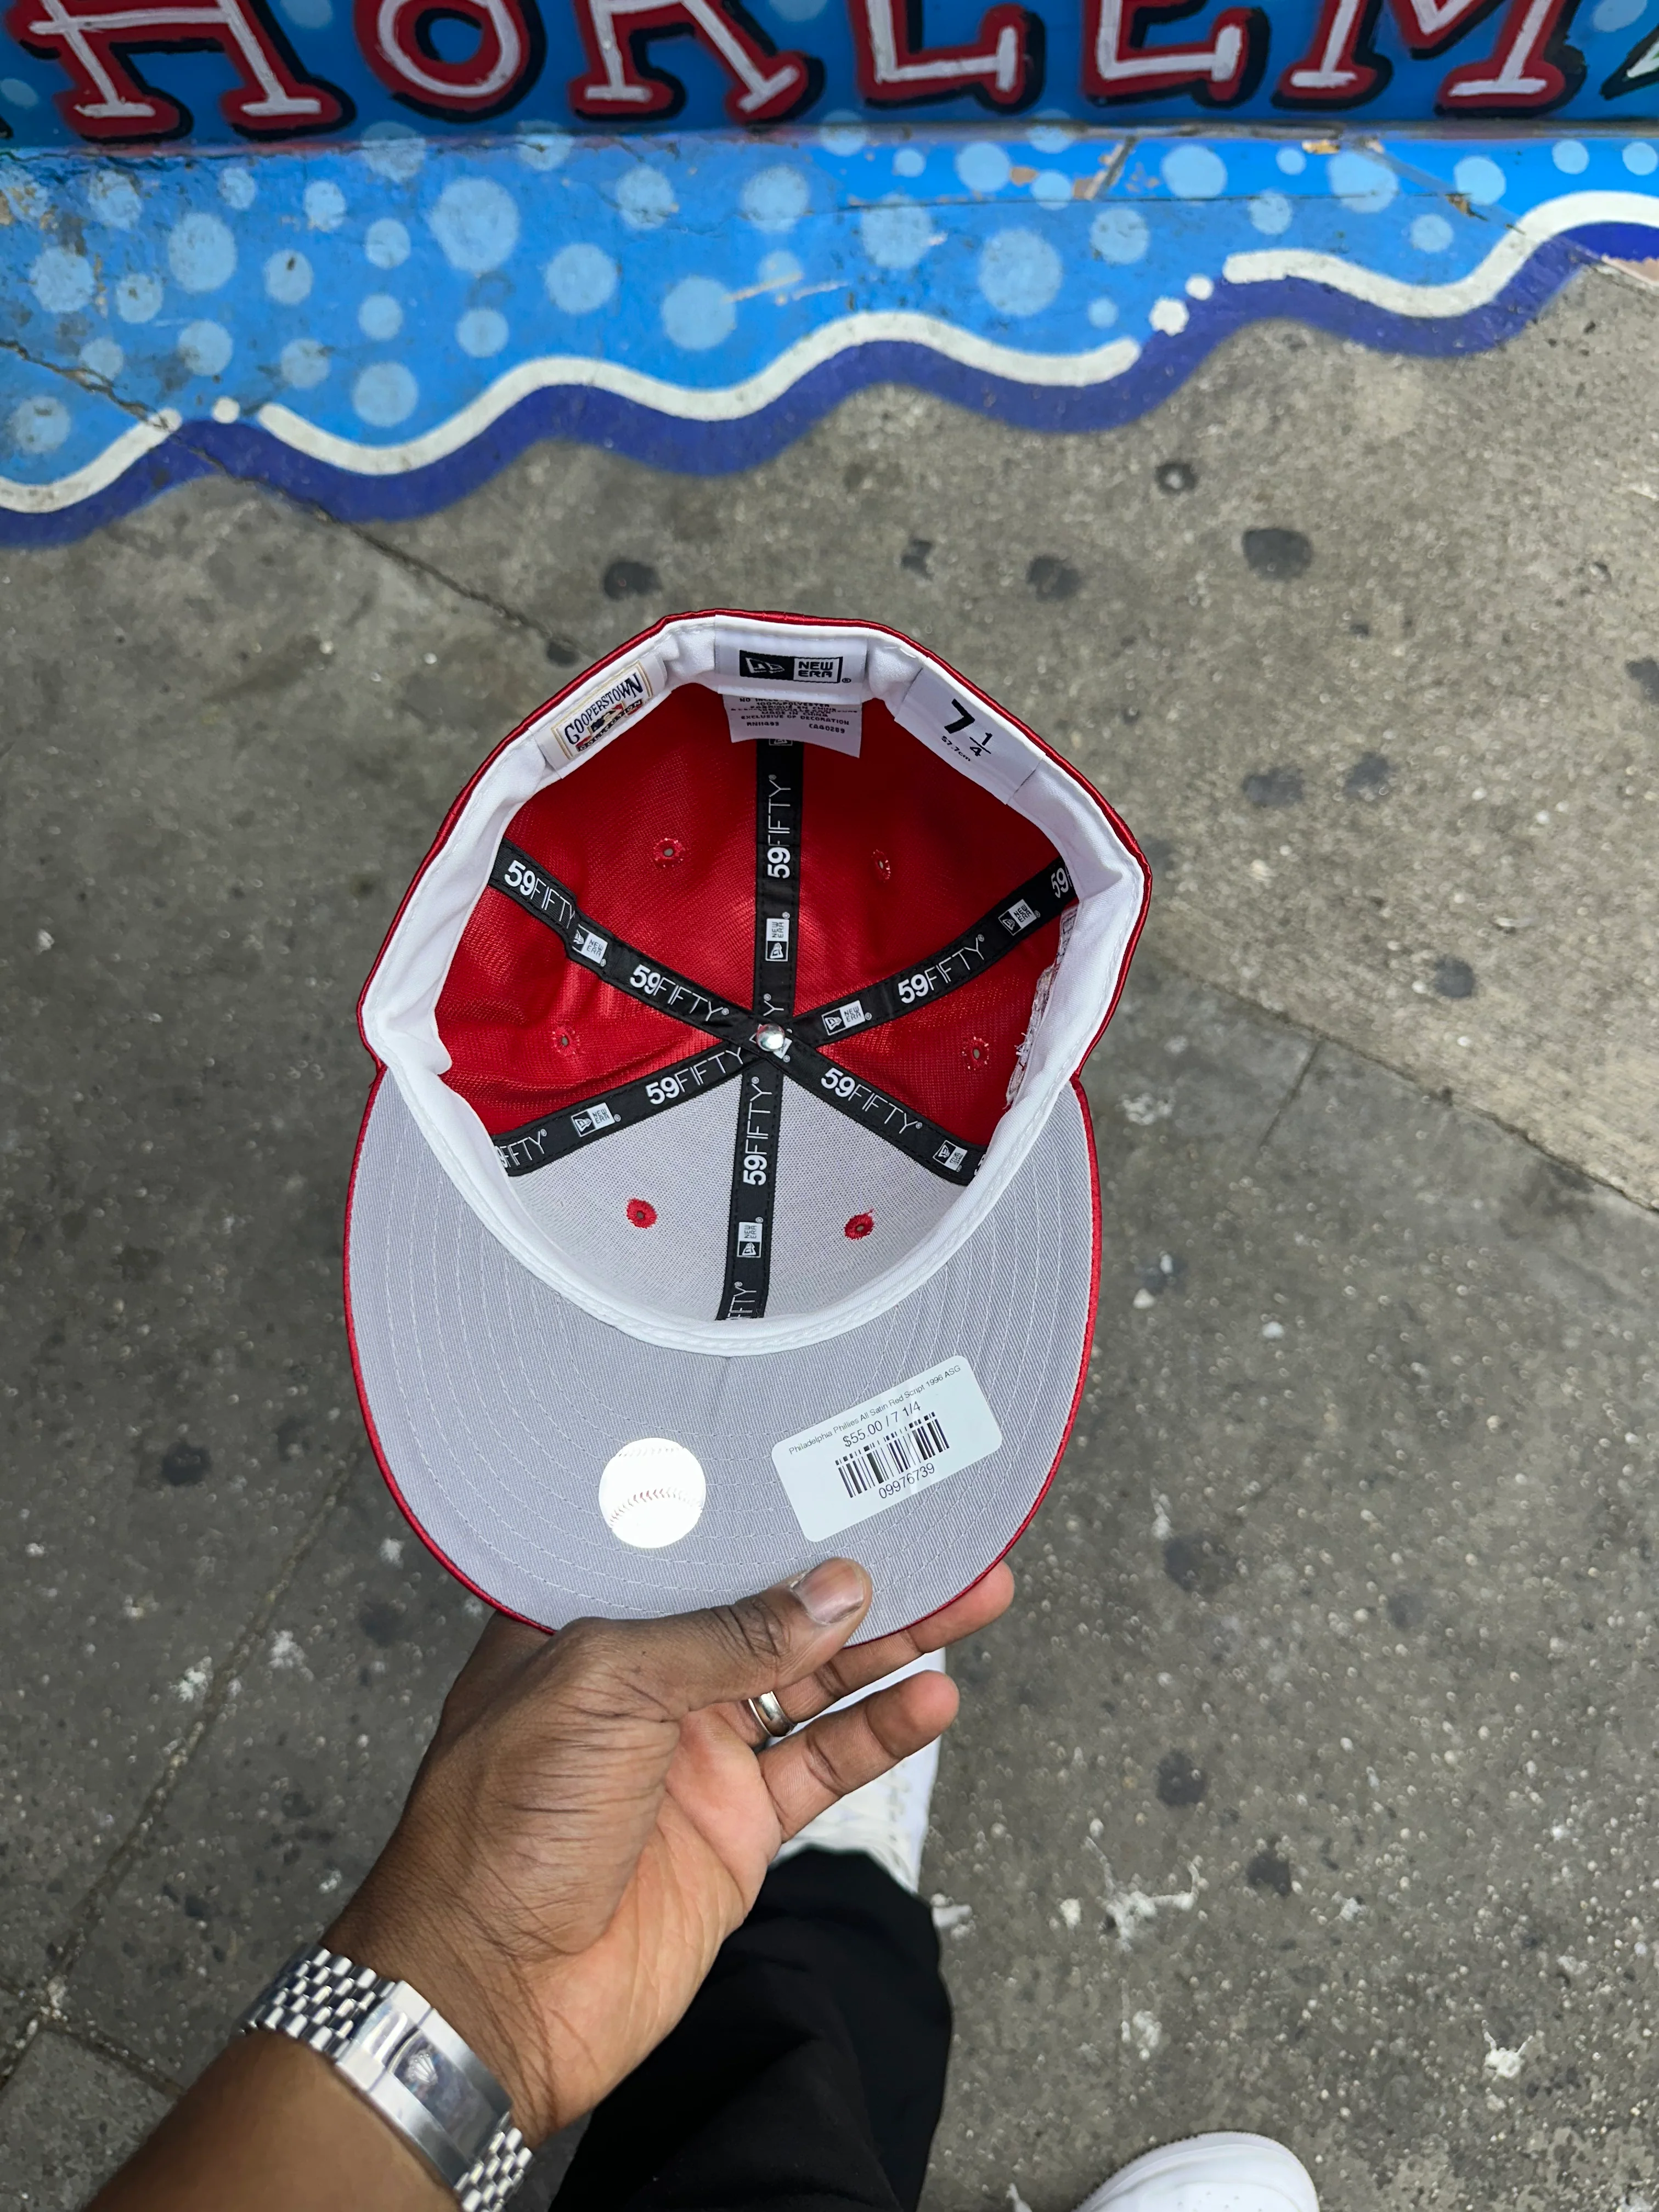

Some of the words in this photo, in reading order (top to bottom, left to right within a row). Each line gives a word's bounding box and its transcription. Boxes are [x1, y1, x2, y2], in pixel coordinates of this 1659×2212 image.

[799, 661, 833, 670] NEW
[565, 673, 644, 745] COOPERSTOWN
[800, 715, 849, 725] DECORATION
[944, 698, 975, 734] 7
[504, 860, 575, 929] 59FIFTY
[1013, 904, 1028, 917] NEW
[1018, 910, 1032, 922] ERA
[586, 945, 601, 956] ERA
[589, 939, 603, 951] NEW
[898, 938, 985, 1003] 59FIFTY
[630, 964, 723, 1021] 59FIFTY
[844, 1006, 859, 1015] NEW
[846, 1012, 861, 1022] ERA
[645, 1047, 743, 1104] 59FIFTY
[592, 1108, 607, 1118] NEW
[821, 1067, 918, 1134] 59FIFTY
[595, 1114, 610, 1124] ERA
[743, 1083, 772, 1185] 59FIFTY
[789, 1431, 833, 1454] Philadelphia
[833, 1418, 859, 1433] Phillies
[860, 1412, 870, 1421] All
[870, 1404, 888, 1416] Satin
[889, 1394, 904, 1406] Red
[904, 1384, 926, 1398] Script
[926, 1374, 944, 1387] 1996
[945, 1365, 961, 1378] ASG
[843, 1420, 883, 1447] $55.00
[891, 1411, 898, 1423] 7
[902, 1401, 921, 1417] 1/4
[879, 1463, 935, 1499] 09976739
